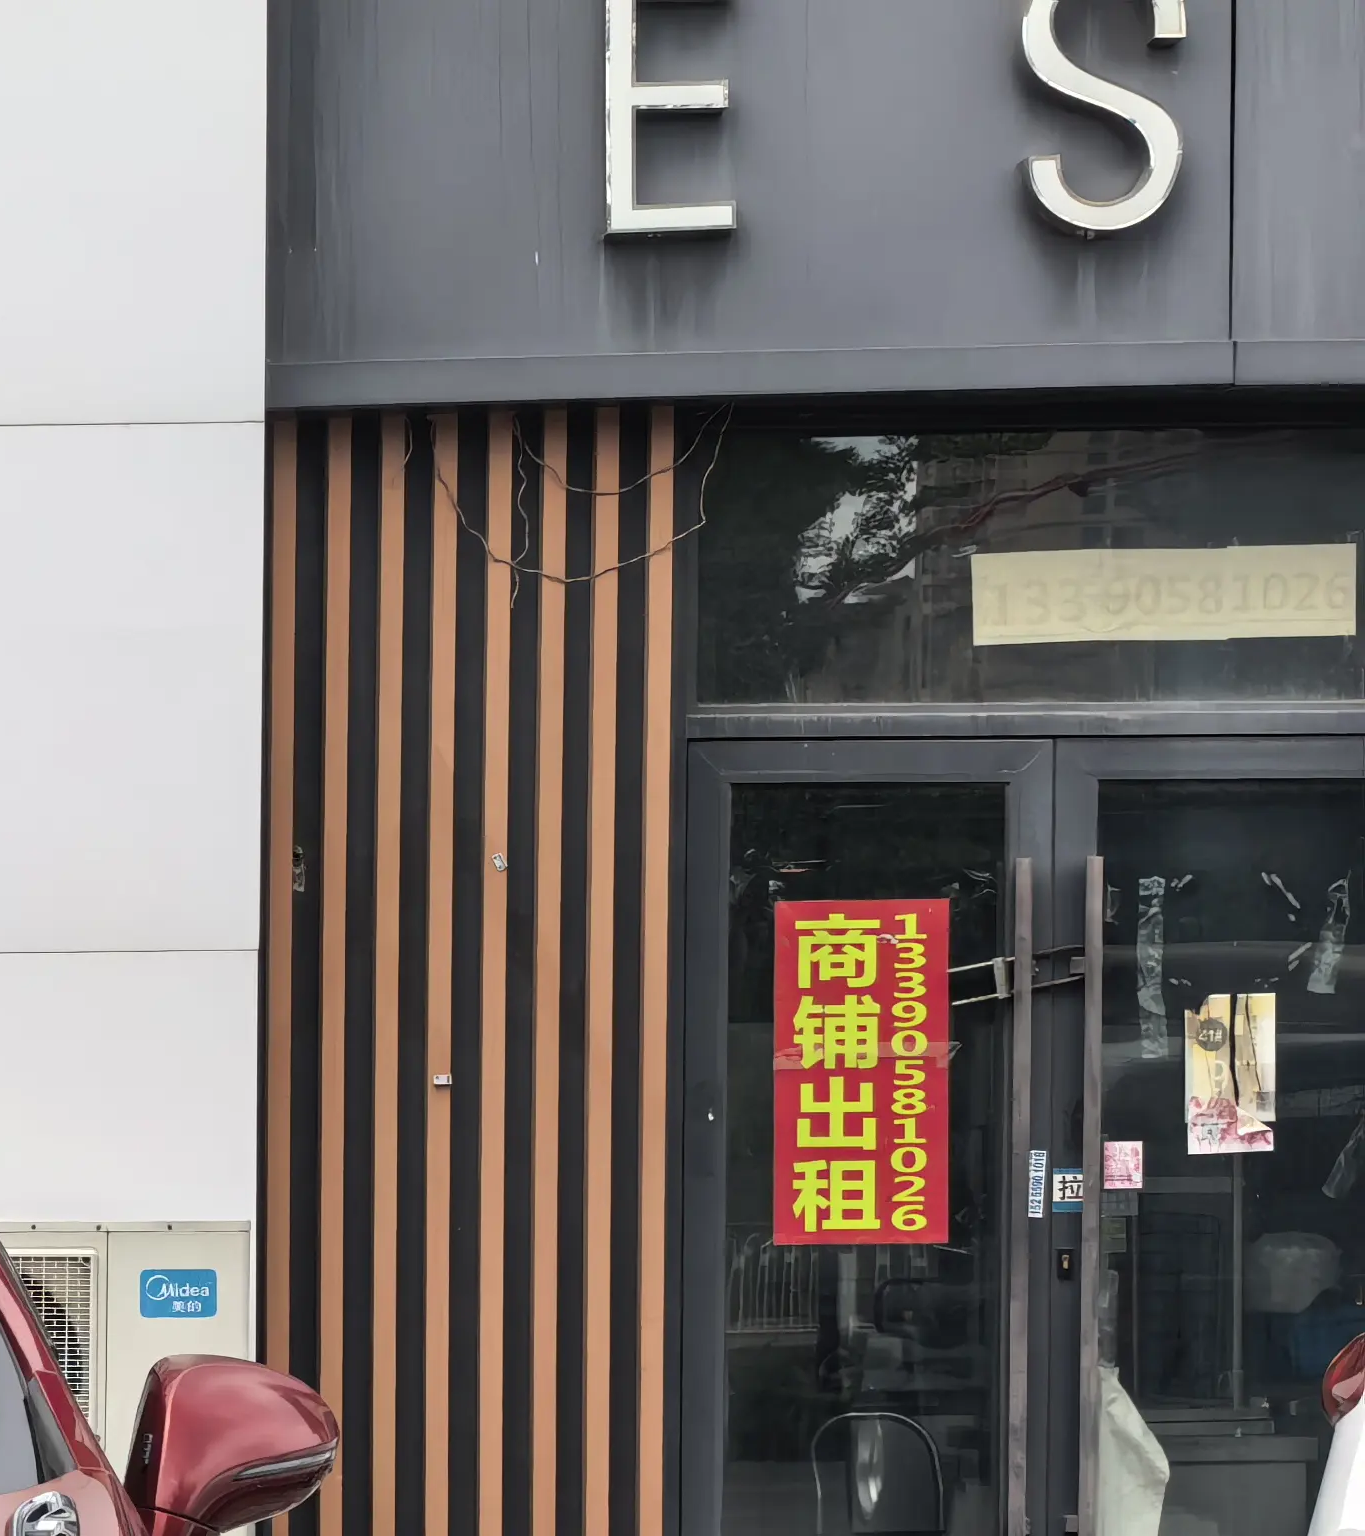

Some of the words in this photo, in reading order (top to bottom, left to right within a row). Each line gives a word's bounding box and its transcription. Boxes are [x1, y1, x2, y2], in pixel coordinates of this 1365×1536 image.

[792, 913, 881, 1232] 商铺出租
[890, 913, 928, 1231] 13390581026
[1057, 1175, 1084, 1201] 拉
[147, 1277, 210, 1299] Midea
